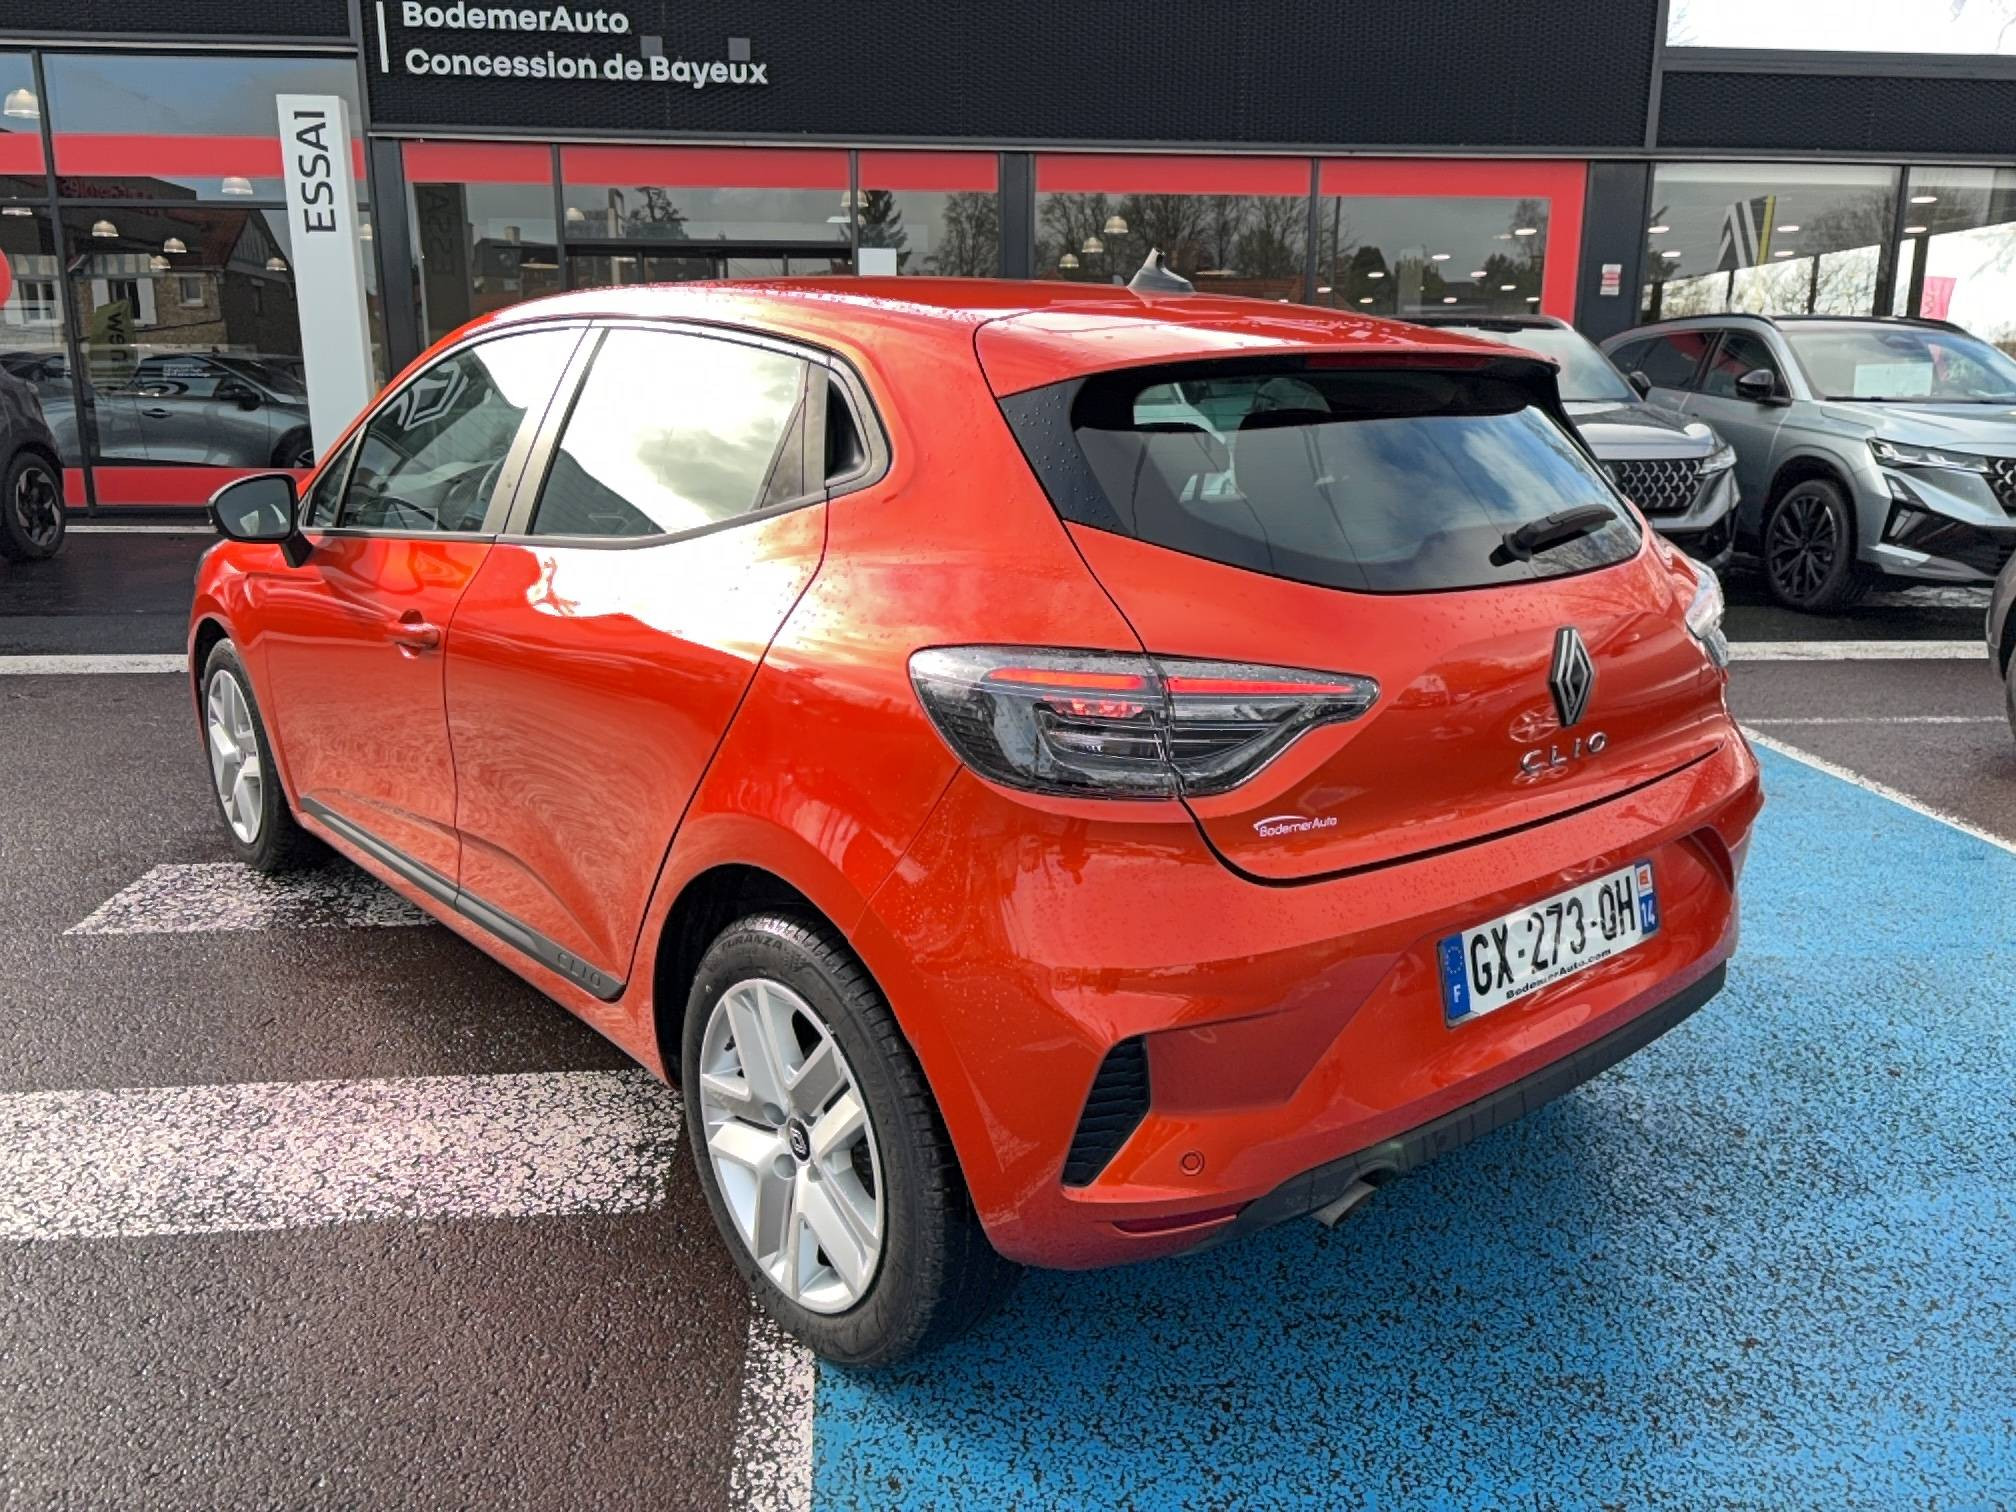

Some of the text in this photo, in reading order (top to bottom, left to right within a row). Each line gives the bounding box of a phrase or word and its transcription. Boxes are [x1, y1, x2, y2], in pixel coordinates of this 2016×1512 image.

[402, 1, 630, 34] BodemerAuto
[405, 48, 768, 89] Concession de Bayeux
[293, 110, 337, 233] ESSAI
[1521, 731, 1607, 773] CLIO
[1259, 817, 1338, 837] BodemerAuto
[1640, 899, 1656, 928] 14
[556, 951, 601, 989] CLIO
[1453, 984, 1461, 1003] F
